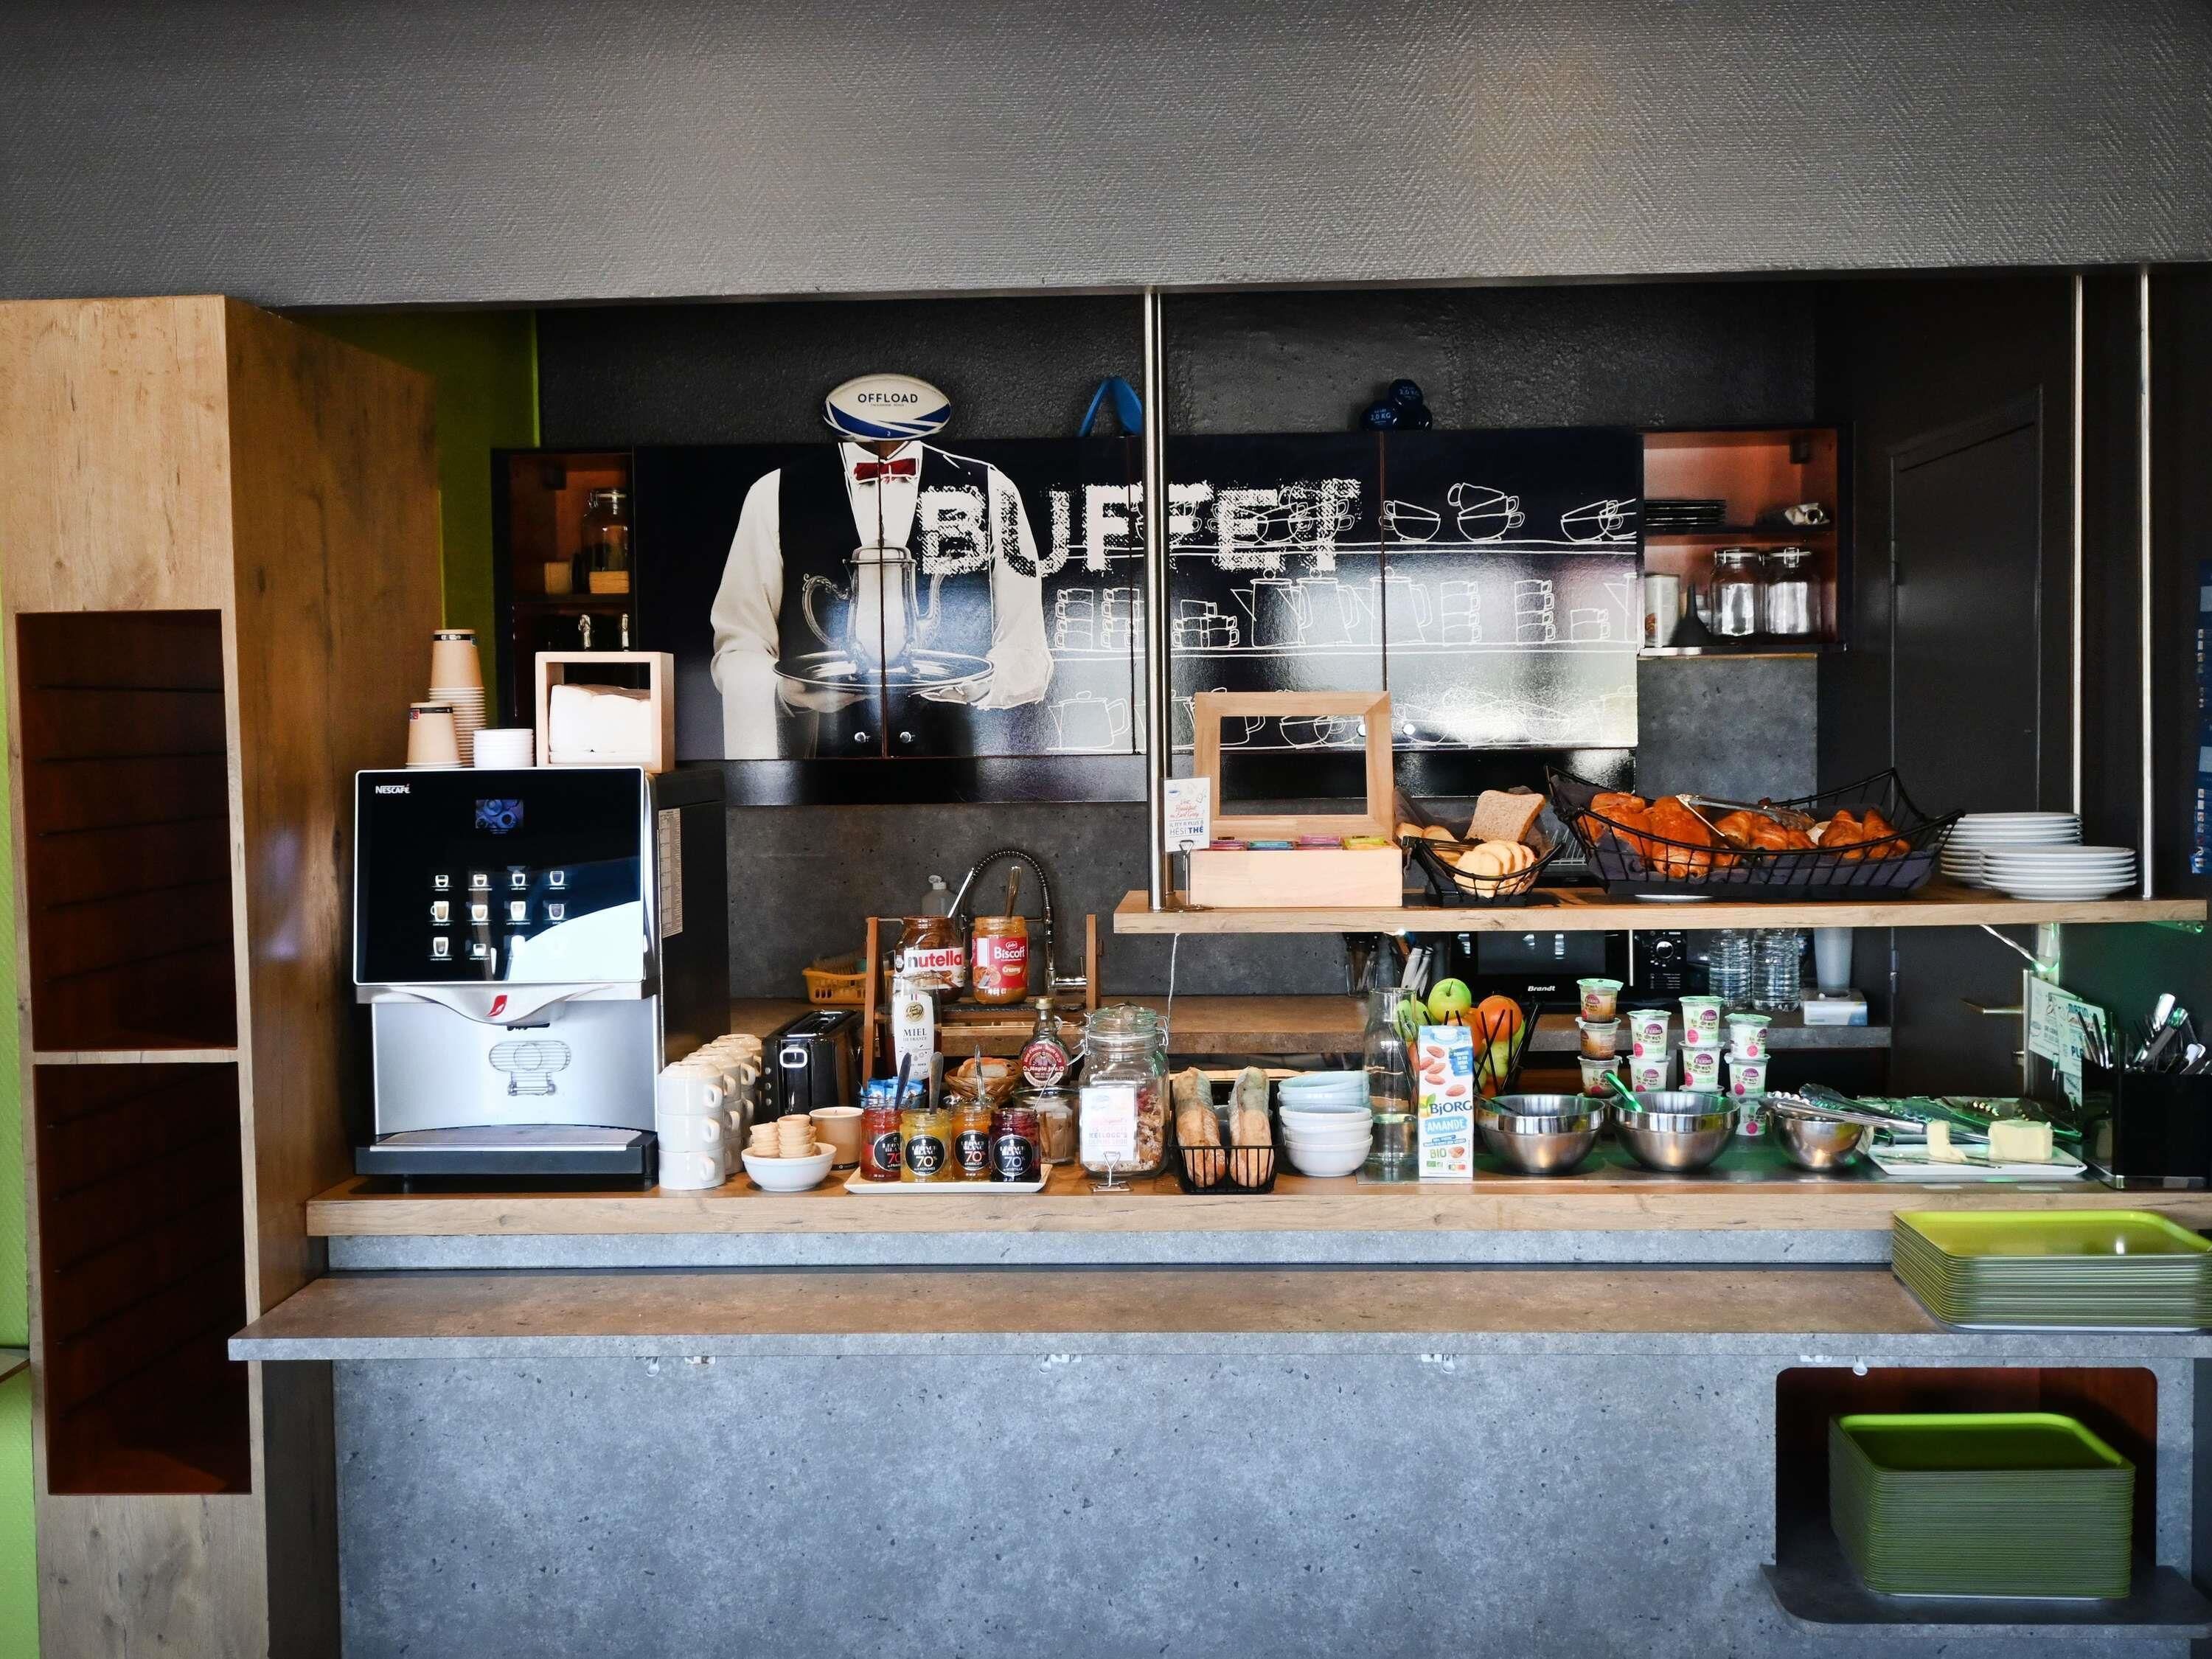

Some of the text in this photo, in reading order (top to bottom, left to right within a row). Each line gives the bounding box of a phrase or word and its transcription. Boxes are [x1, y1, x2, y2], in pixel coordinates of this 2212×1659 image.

[858, 393, 918, 403] OFFLOAD
[917, 479, 1361, 577] BUFFET
[375, 784, 411, 794] NESCAFÉ
[994, 945, 1025, 959] Biscoff
[908, 950, 962, 967] nutella
[903, 1028, 927, 1037] MIEL
[1427, 1119, 1464, 1133] AMANDE
[1430, 1148, 1447, 1158] BIO
